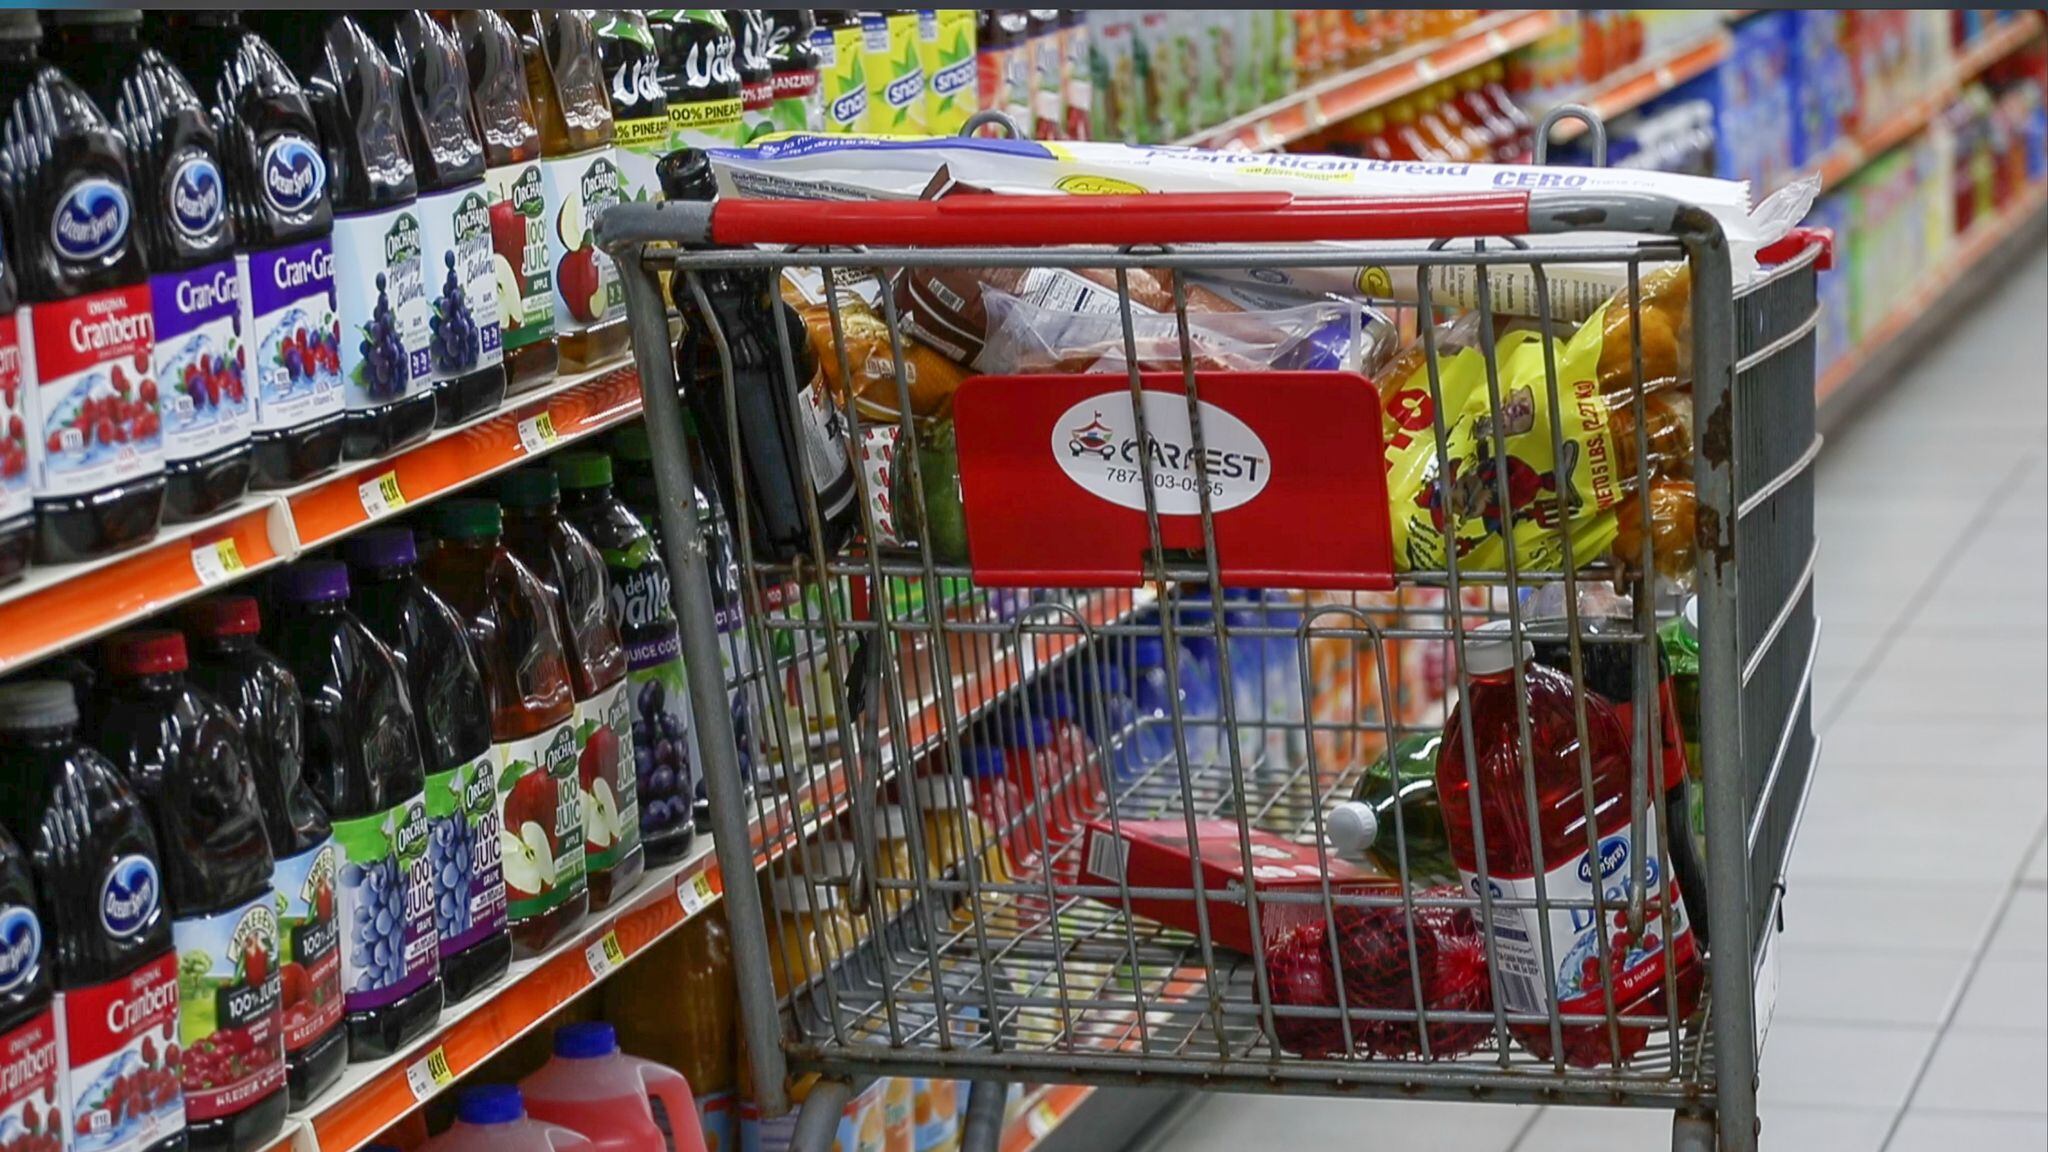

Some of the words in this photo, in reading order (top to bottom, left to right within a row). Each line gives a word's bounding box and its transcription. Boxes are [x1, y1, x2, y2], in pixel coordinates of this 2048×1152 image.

[667, 108, 702, 122] 100%
[595, 163, 606, 174] OLD
[1268, 155, 1360, 171] Rican
[1367, 161, 1470, 176] Bread
[526, 170, 537, 182] OLD
[1492, 170, 1588, 187] CERO
[583, 170, 619, 200] ORCHARD
[466, 197, 477, 210] OLD
[399, 219, 410, 231] OLD
[454, 207, 490, 239] ORCHARD
[386, 228, 421, 262] ORCHARD
[533, 277, 548, 290] APPLE
[69, 312, 156, 354] Cranberry
[1105, 466, 1225, 497] 787-03-0555
[625, 571, 645, 597] del
[558, 730, 570, 744] OLD
[478, 765, 488, 779] OLD
[410, 806, 422, 820] OLD
[565, 834, 580, 849] APPLE
[1604, 844, 1627, 872] Spray
[259, 976, 282, 1004] JUICE
[1623, 976, 1634, 989] 1g
[107, 979, 178, 1034] Cranberry
